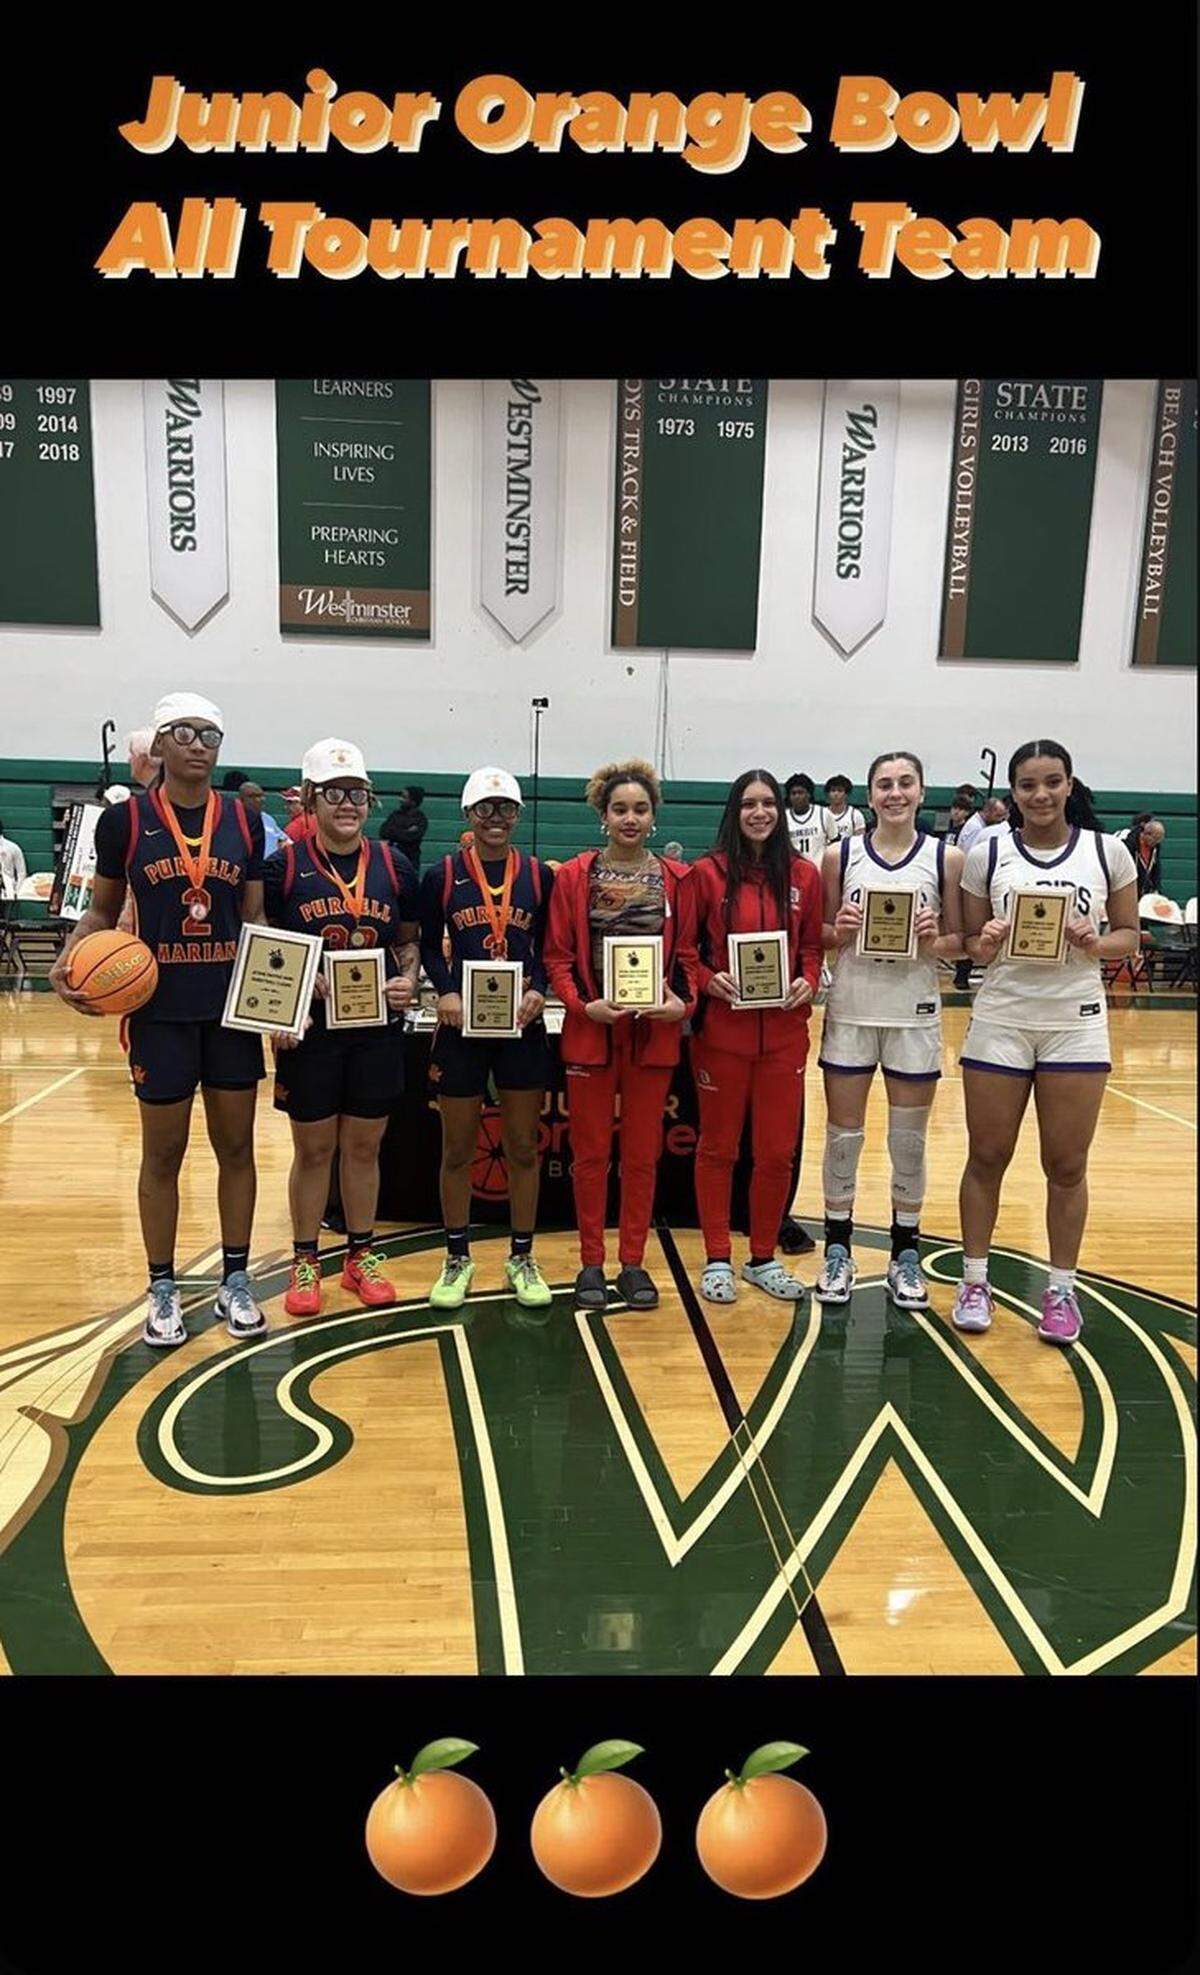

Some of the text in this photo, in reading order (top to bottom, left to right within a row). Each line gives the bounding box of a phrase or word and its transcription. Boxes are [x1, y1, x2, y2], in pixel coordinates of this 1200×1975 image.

[36, 386, 77, 404] 1997
[313, 379, 394, 399] LEARNERS
[658, 392, 753, 406] CHAMPIONS
[996, 382, 1089, 410] STATE
[38, 414, 79, 432] 2014
[994, 409, 1087, 423] CHAMPIONS
[657, 417, 755, 439] 1973 1975
[39, 443, 80, 461] 2018
[313, 442, 395, 461] INSPIRING
[991, 434, 1087, 455] 2013 2016
[333, 466, 376, 483] LIVES
[621, 429, 640, 512] TRACK
[836, 403, 878, 580] WARRIORS
[949, 379, 981, 600] GIRLS VOLLEYBALL
[1143, 388, 1181, 620] BEACH VOLLEYBALL
[311, 525, 399, 545] PREPARING
[620, 514, 638, 535] &
[324, 549, 386, 567] HEARTS
[618, 540, 637, 607] FIELD
[298, 588, 412, 621] Westminster
[181, 887, 212, 936] 2
